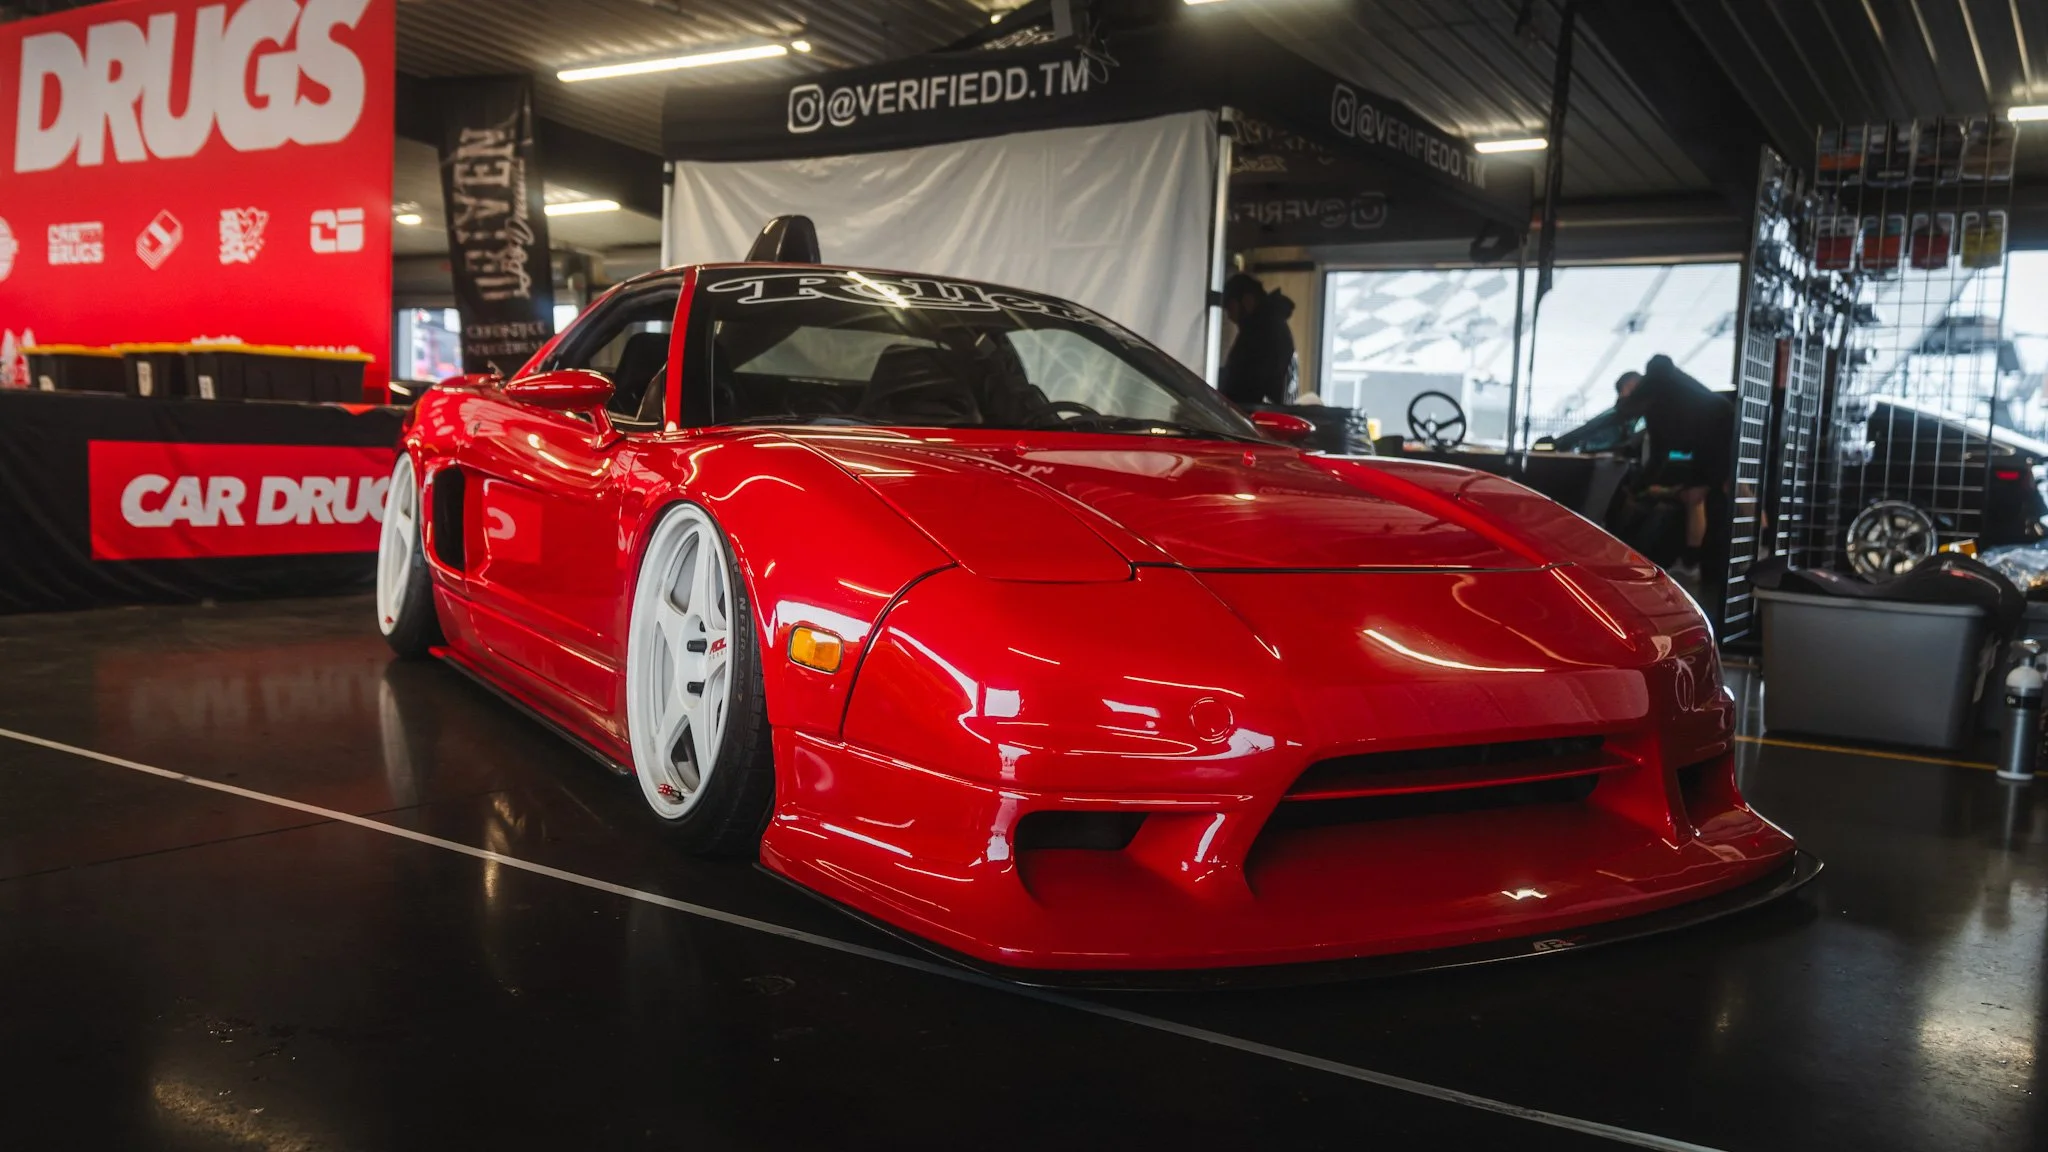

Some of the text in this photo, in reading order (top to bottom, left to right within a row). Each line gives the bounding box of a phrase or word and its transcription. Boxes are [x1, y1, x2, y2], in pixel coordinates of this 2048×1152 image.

[14, 0, 370, 173] DRUGS
[827, 57, 1090, 126] @VERIFIEDD.TM
[1356, 104, 1487, 189] @VERIFIEDD.TM
[120, 473, 246, 528] CAR
